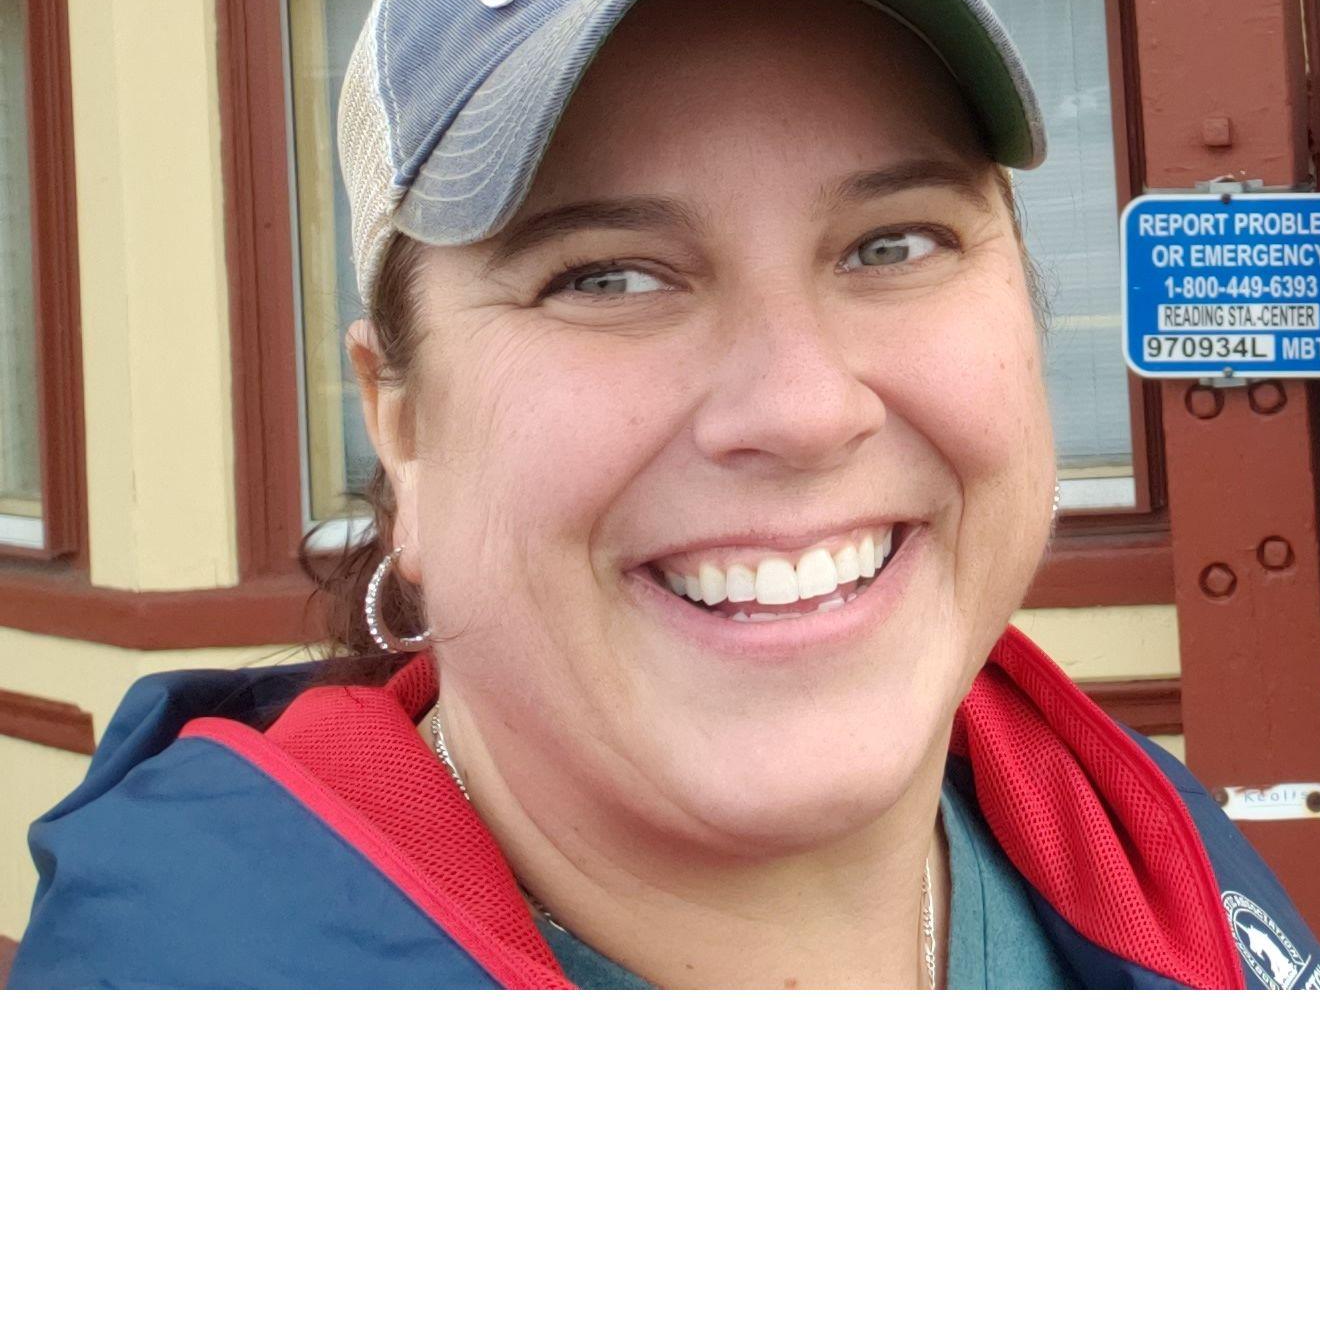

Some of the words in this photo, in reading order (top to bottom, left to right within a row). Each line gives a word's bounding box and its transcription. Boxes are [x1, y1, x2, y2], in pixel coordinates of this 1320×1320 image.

[1139, 213, 1229, 236] REPORT
[1152, 245, 1184, 268] OR
[1164, 275, 1319, 299] 1-800-449-6393
[1164, 306, 1224, 328] READING
[1147, 336, 1268, 358] 970934L
